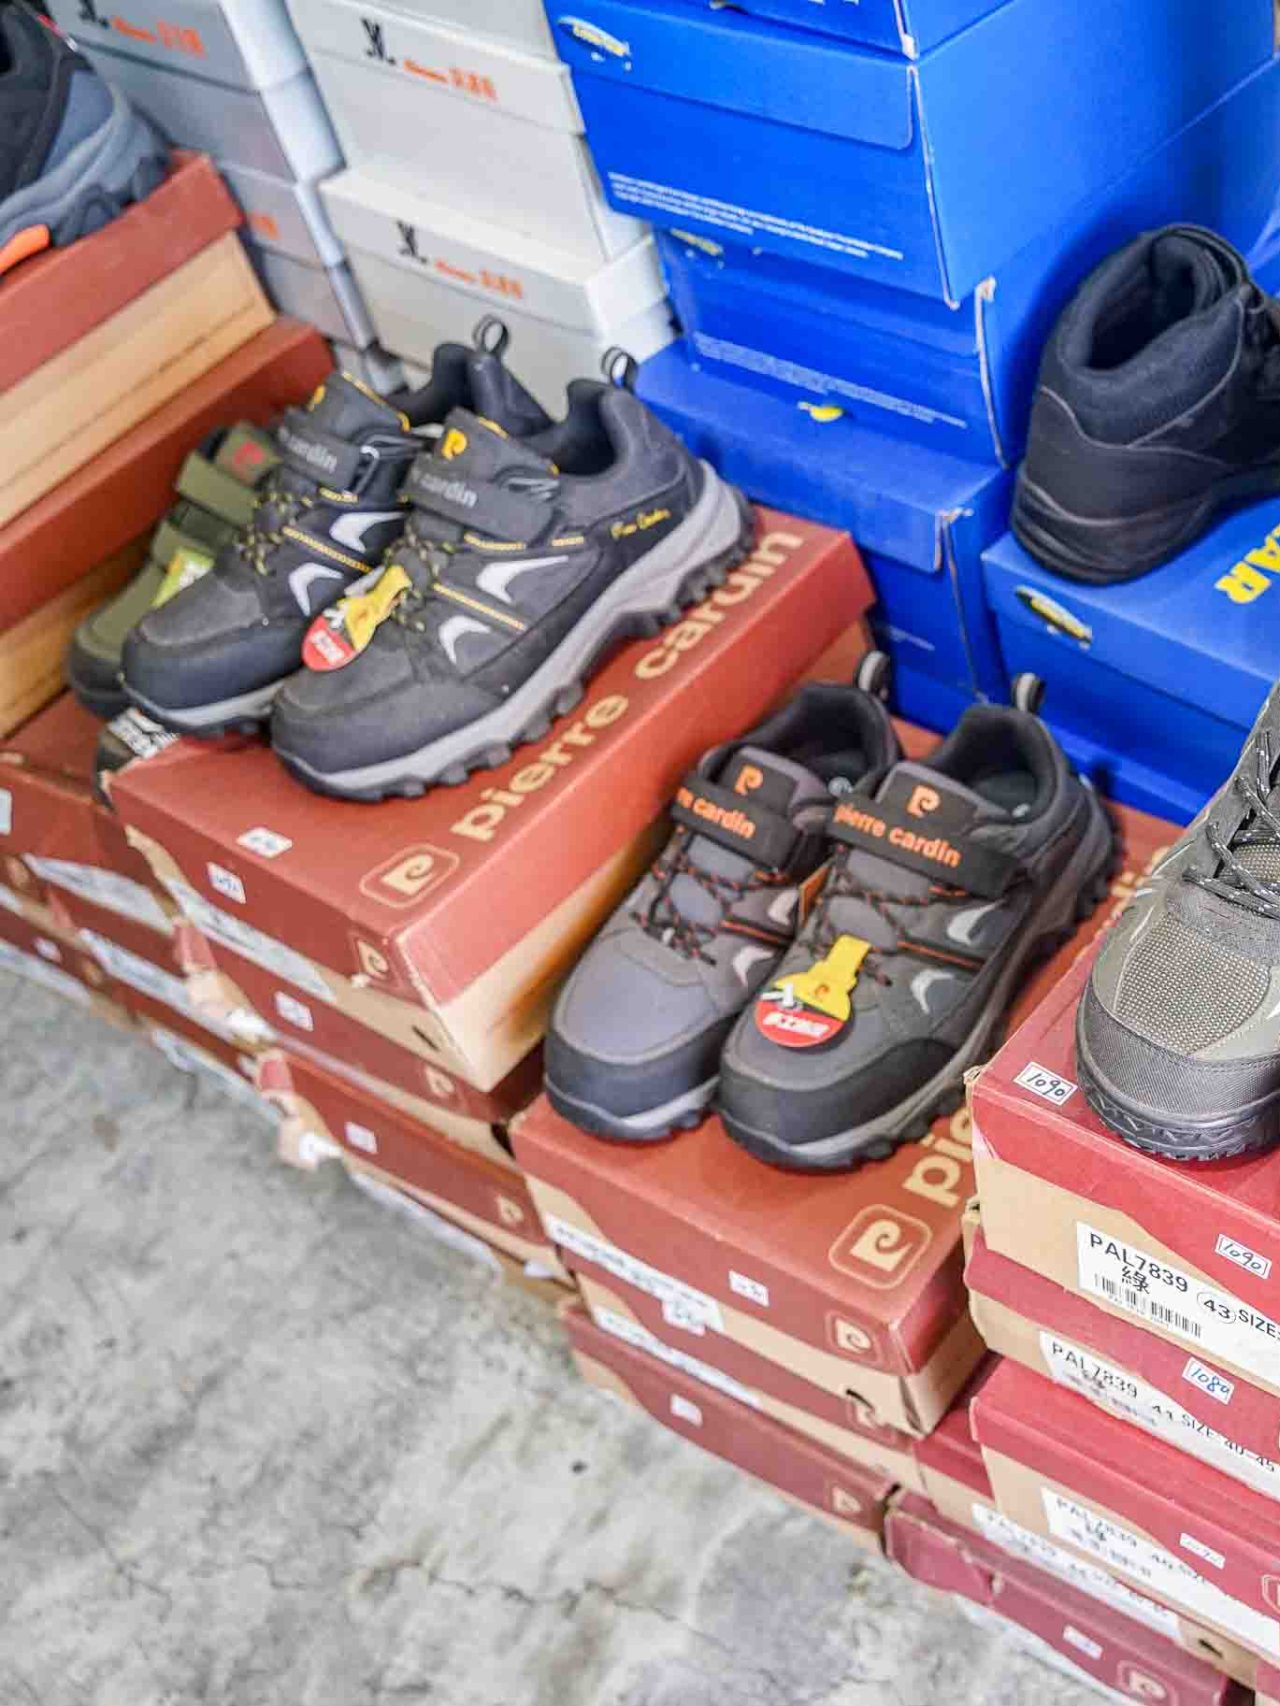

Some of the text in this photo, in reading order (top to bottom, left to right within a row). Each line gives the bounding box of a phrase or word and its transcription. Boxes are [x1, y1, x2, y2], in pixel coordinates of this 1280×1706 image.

[451, 694, 629, 842] pierre
[889, 827, 962, 868] cardin
[1027, 1072, 1065, 1098] 1090
[1219, 1239, 1262, 1271] 1090
[1090, 1233, 1188, 1293] PAL7839
[1203, 1299, 1232, 1320] 43
